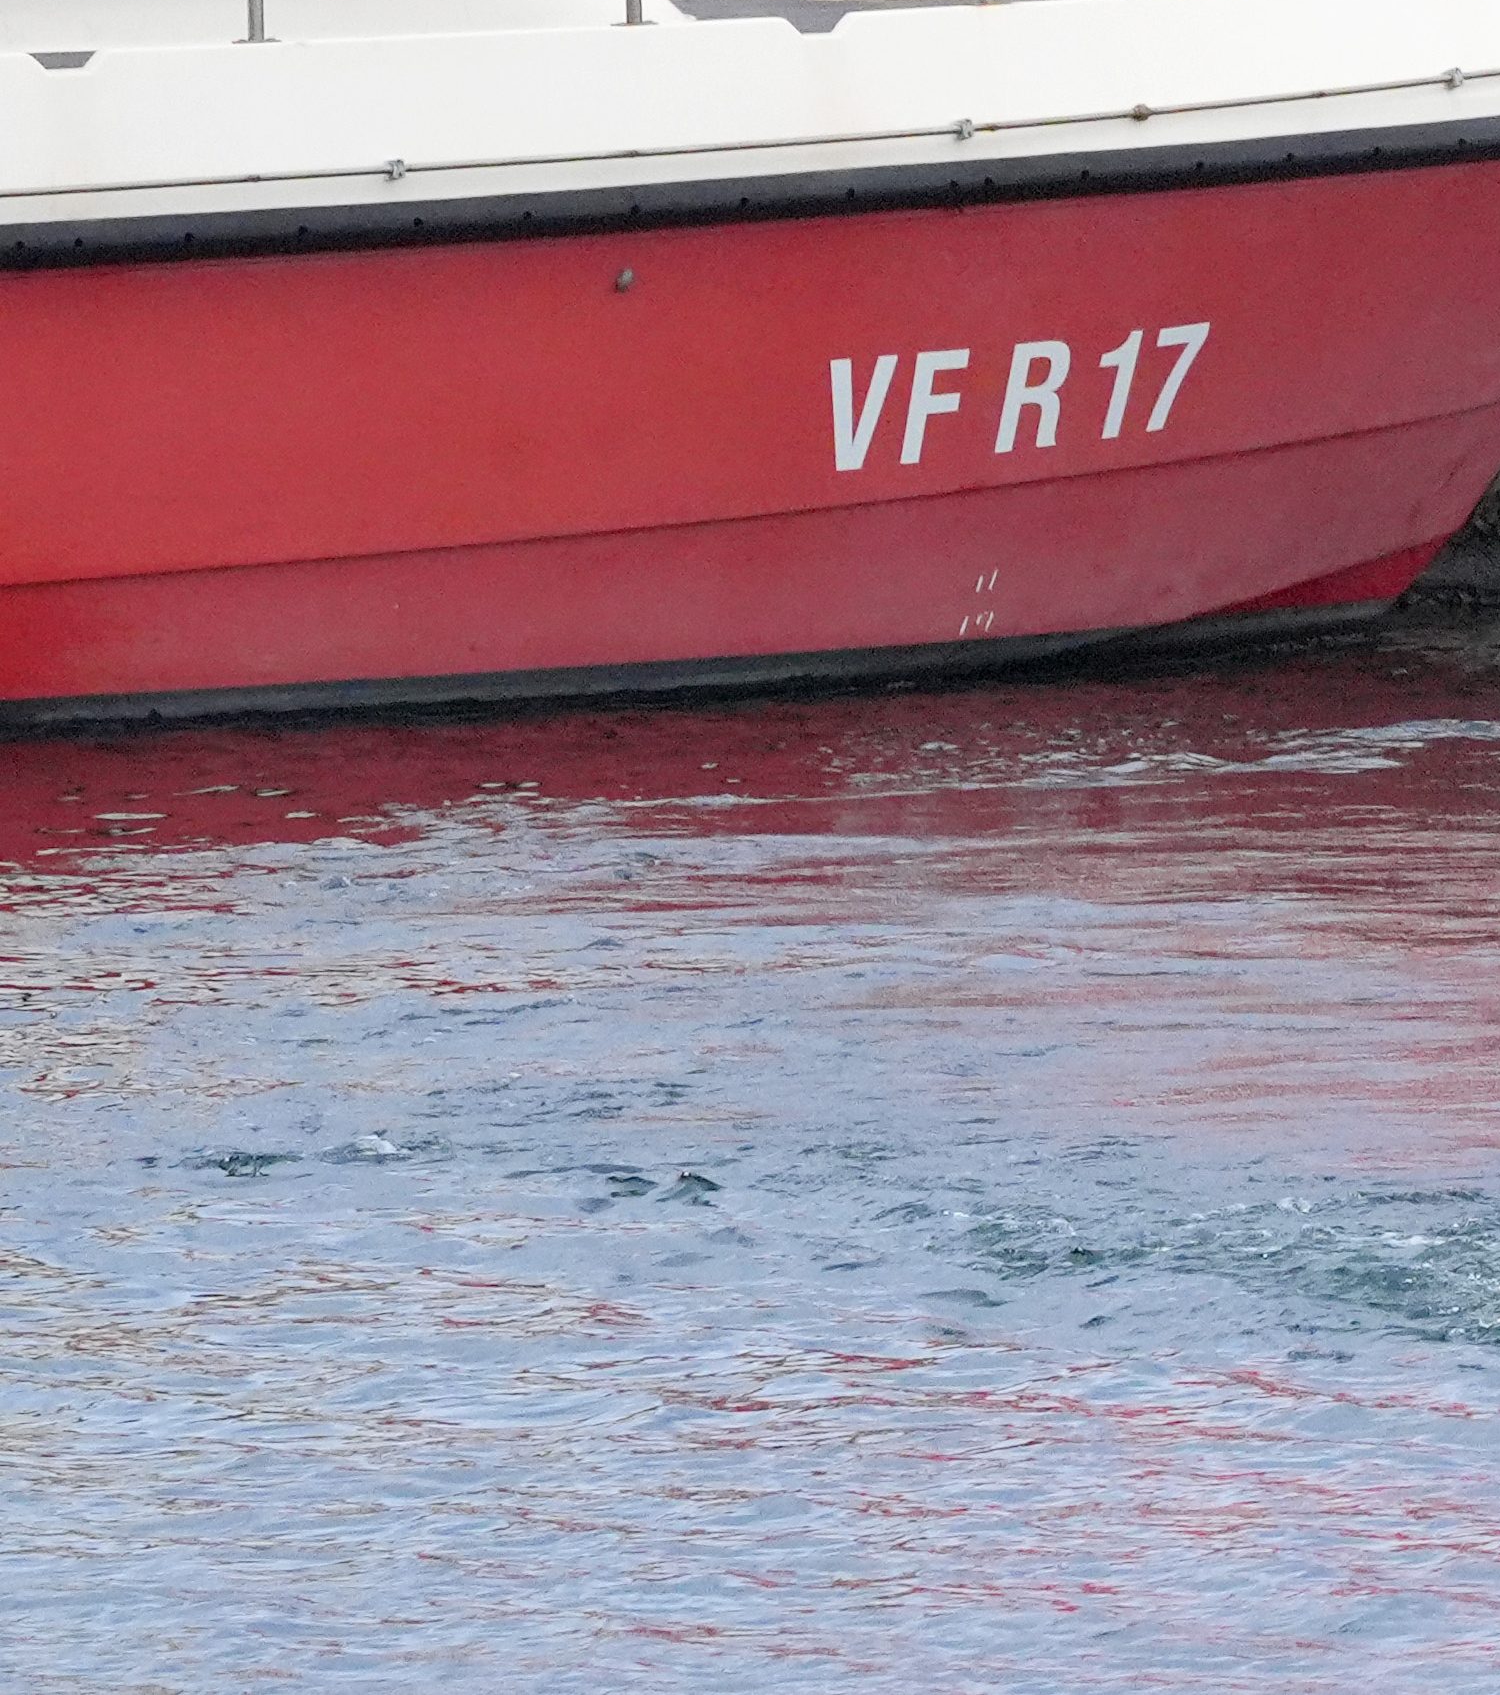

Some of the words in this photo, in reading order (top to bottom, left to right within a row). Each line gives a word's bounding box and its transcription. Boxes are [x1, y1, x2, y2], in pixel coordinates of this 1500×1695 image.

[830, 349, 971, 472] VF
[995, 340, 1071, 454] R
[1099, 321, 1210, 440] 17
